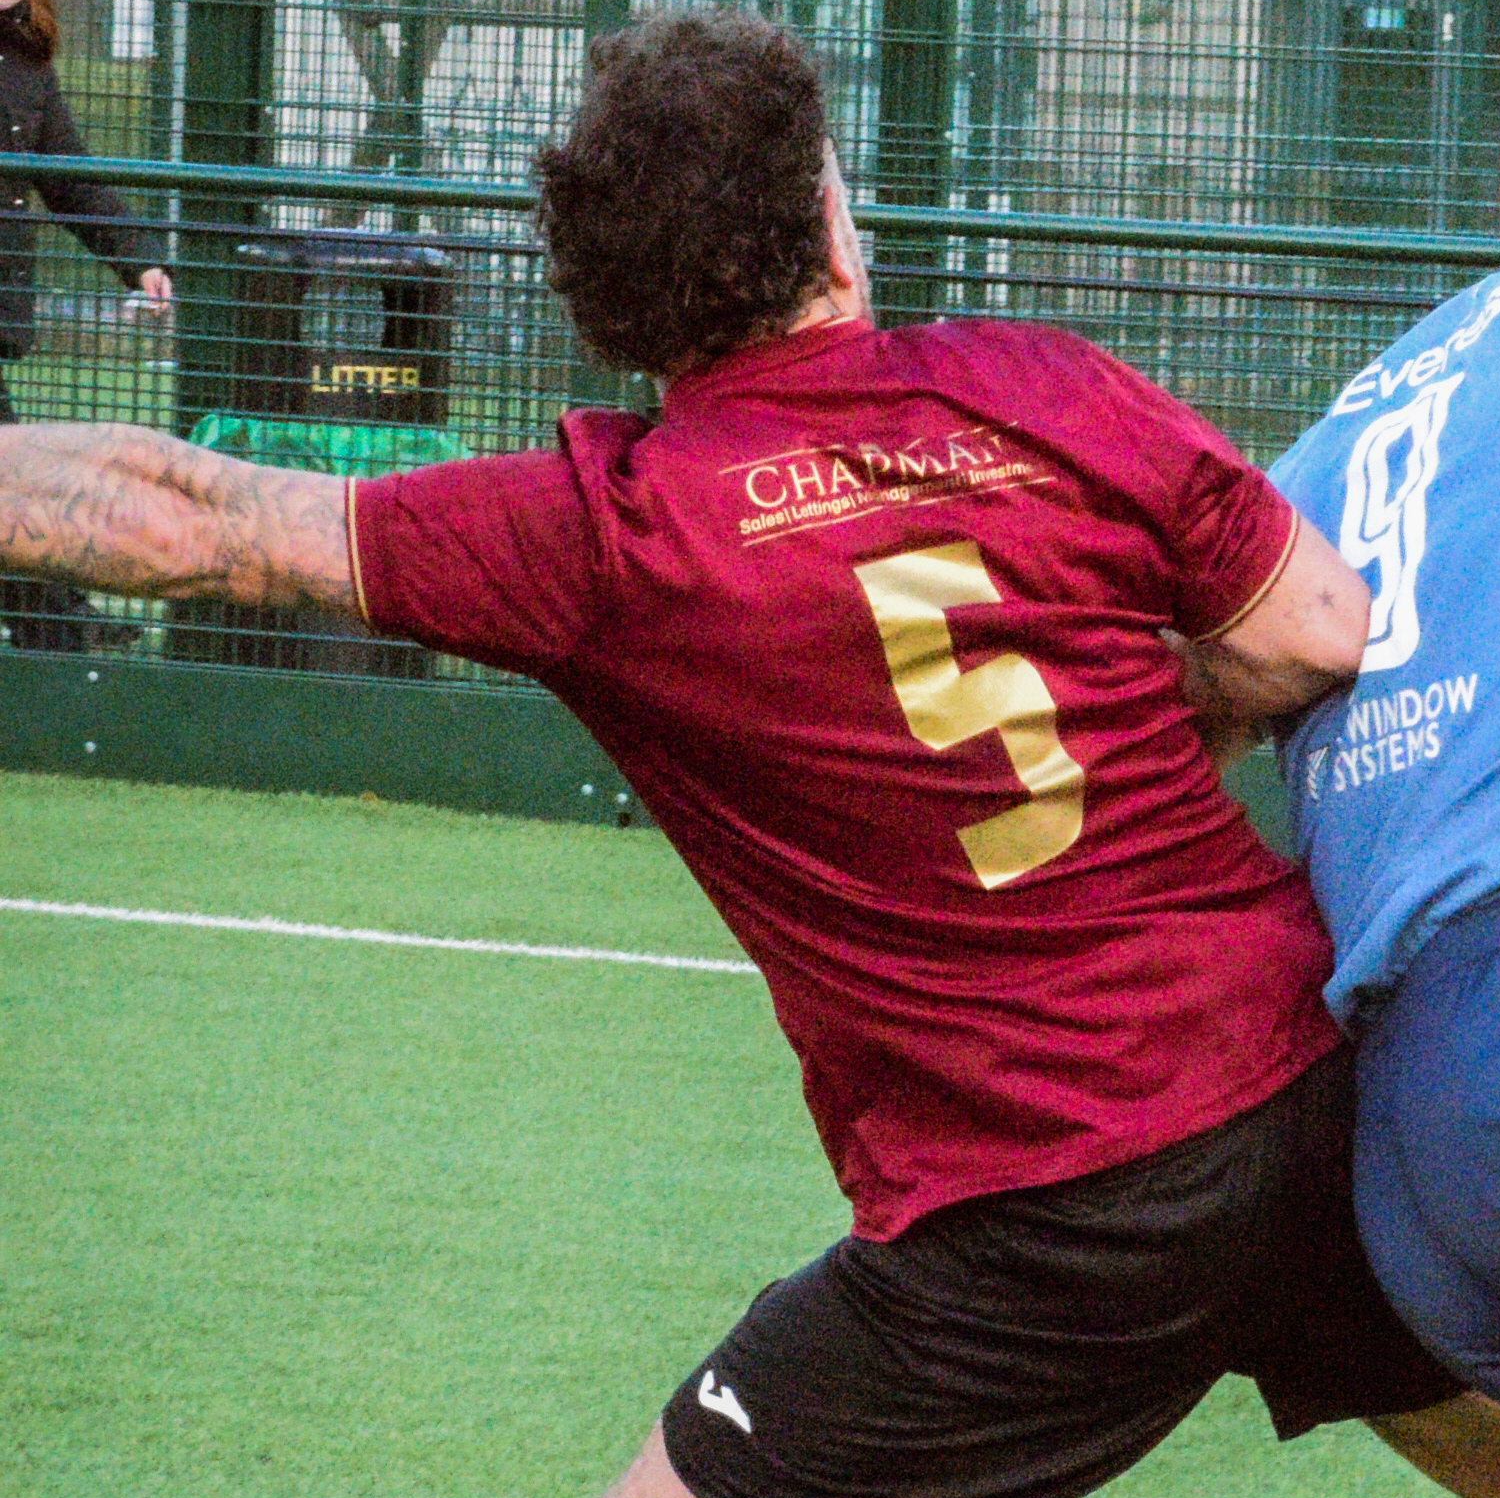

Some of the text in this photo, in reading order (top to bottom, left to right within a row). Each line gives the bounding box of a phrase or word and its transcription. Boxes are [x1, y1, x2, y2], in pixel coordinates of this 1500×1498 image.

[312, 365, 419, 393] LITTER
[1339, 371, 1465, 672] 9
[853, 539, 1086, 890] 5
[1347, 673, 1478, 743] WINDOW
[1333, 721, 1441, 792] SYSTEMS
